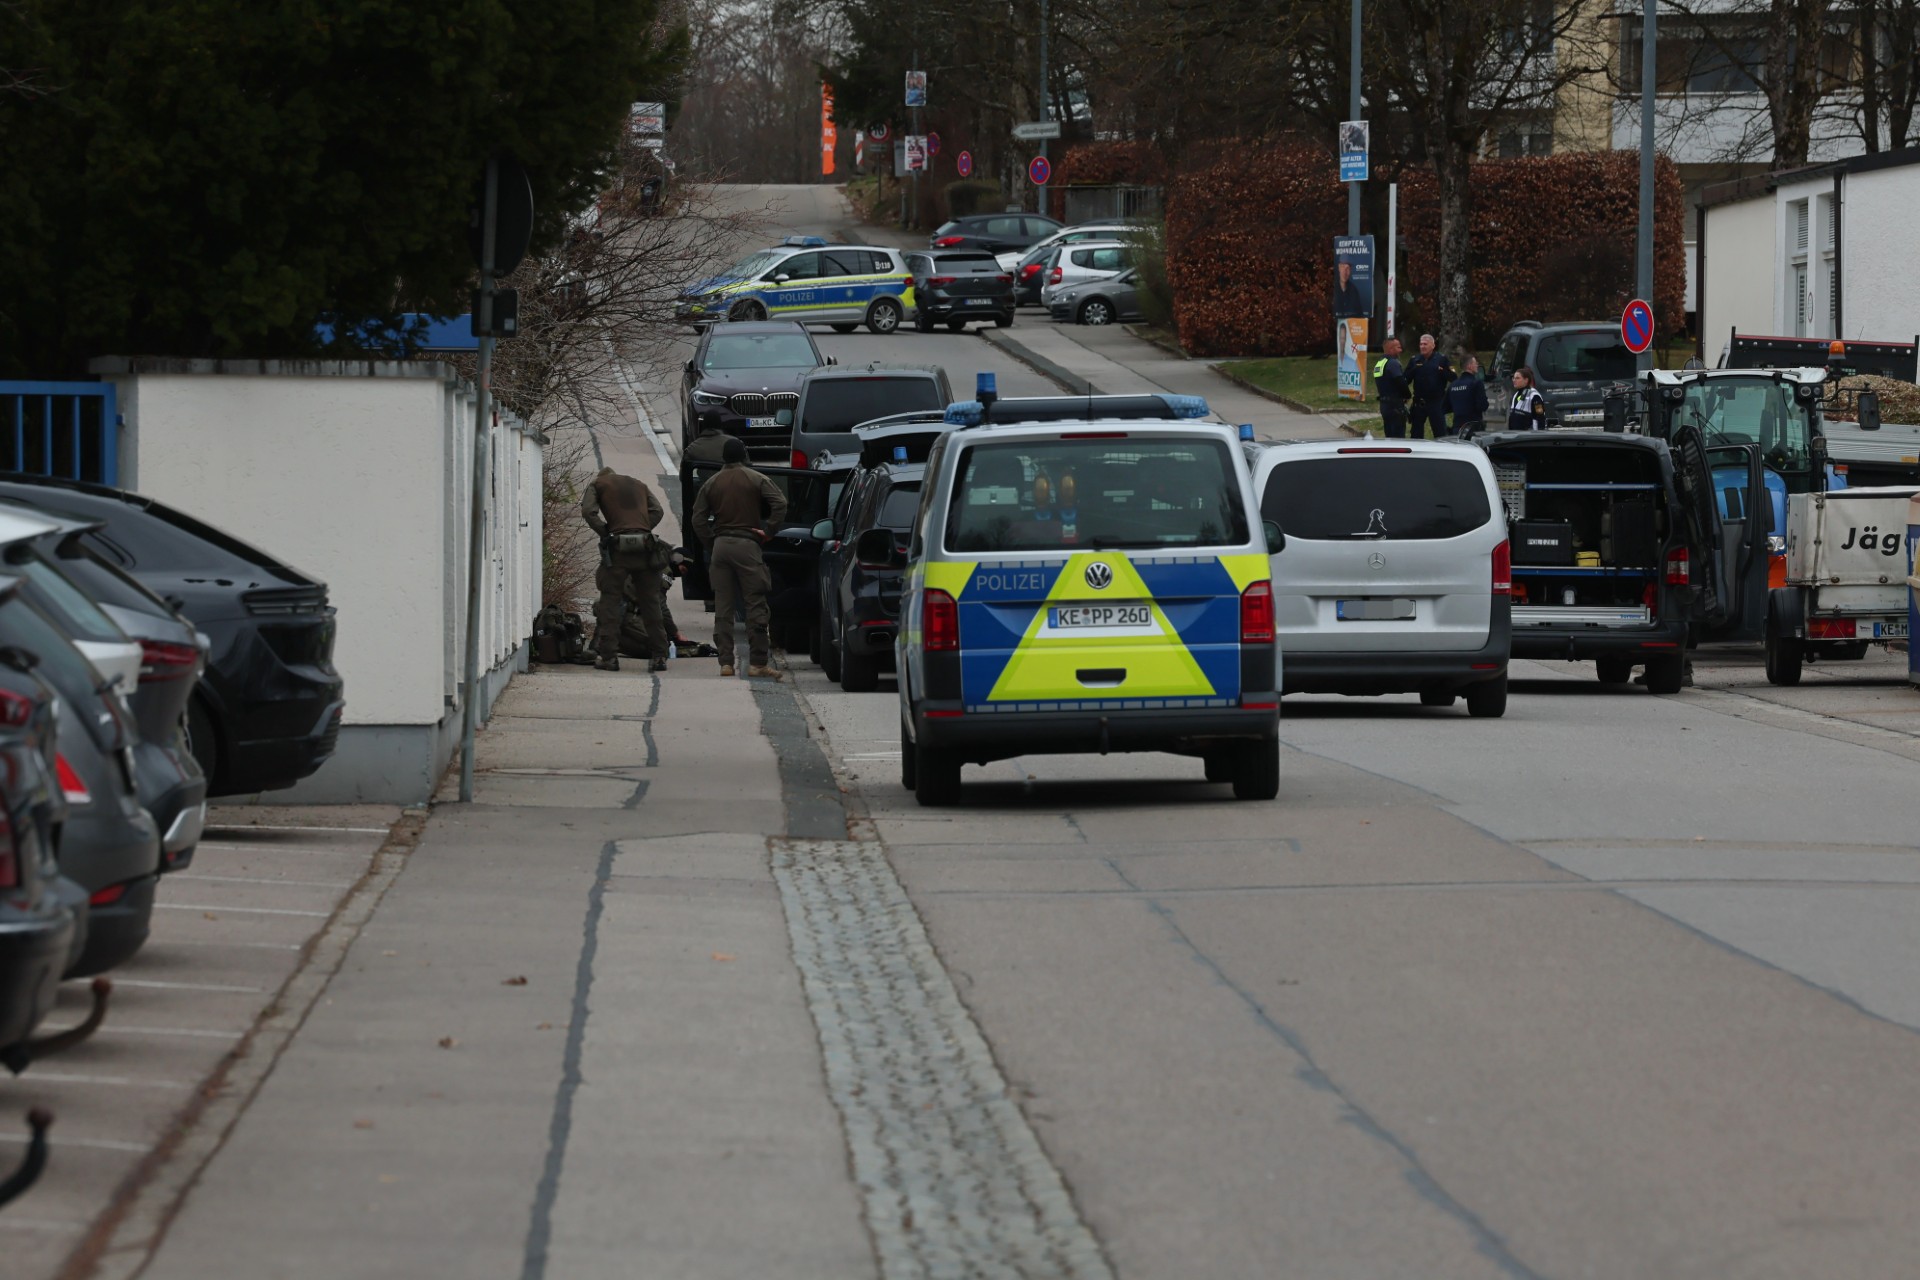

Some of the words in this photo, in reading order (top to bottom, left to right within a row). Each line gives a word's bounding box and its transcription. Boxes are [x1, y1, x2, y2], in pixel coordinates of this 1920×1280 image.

[779, 292, 815, 303] POLIZEI
[1841, 525, 1908, 556] Jäg
[976, 573, 1046, 591] POLIZEI
[1058, 608, 1081, 625] KE
[1092, 607, 1113, 624] PP
[1117, 607, 1149, 624] 260
[1880, 623, 1894, 635] KE
